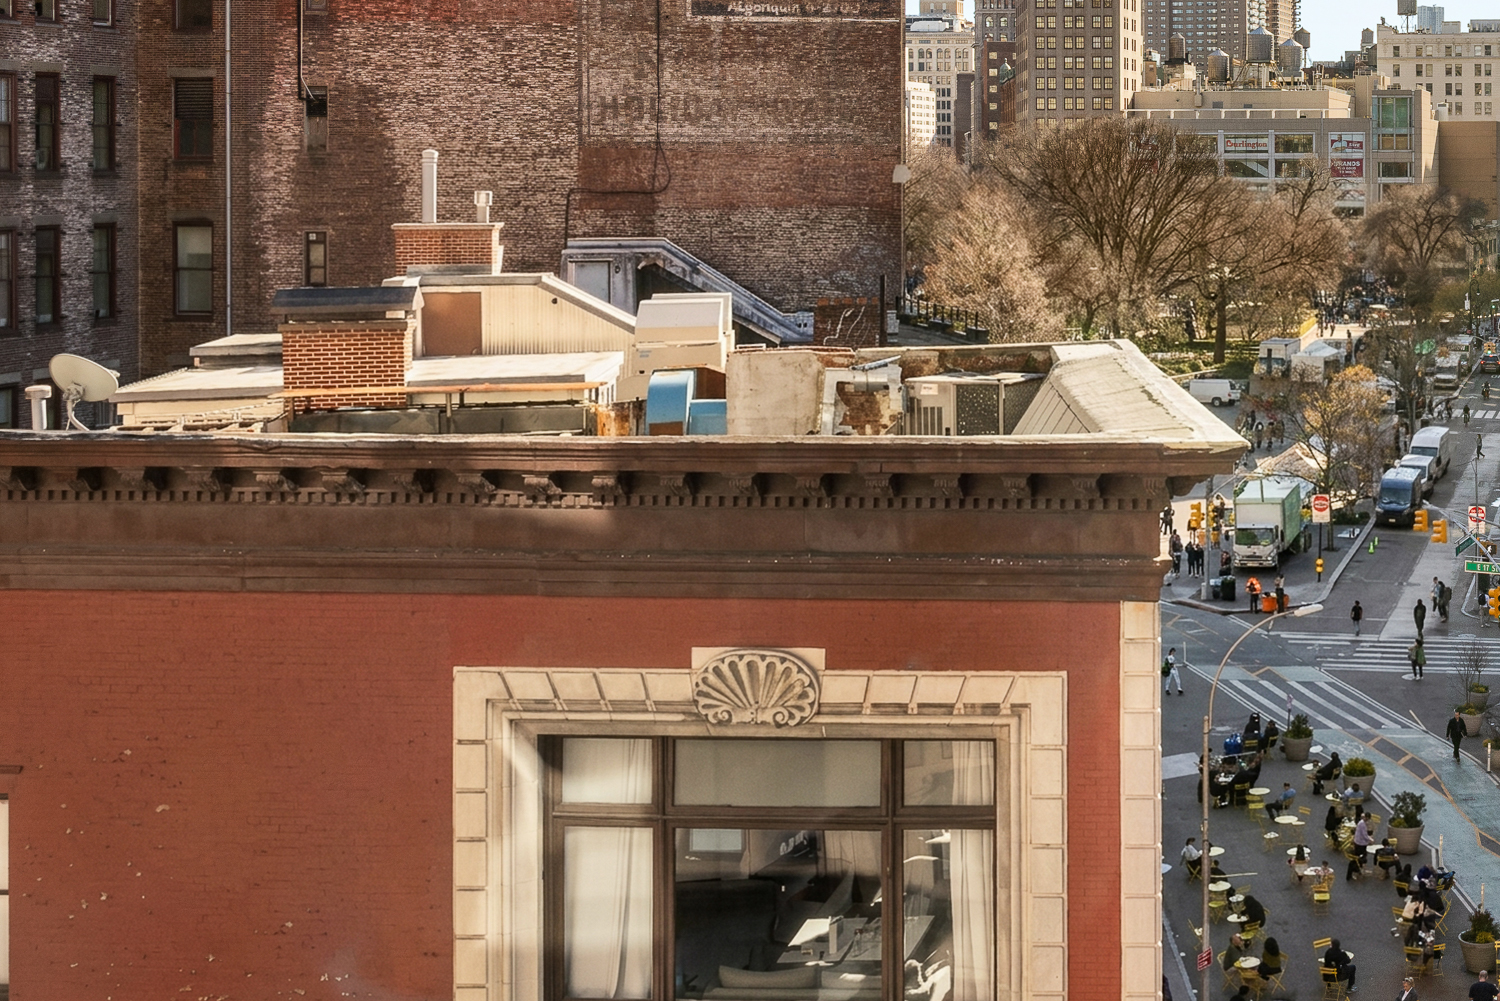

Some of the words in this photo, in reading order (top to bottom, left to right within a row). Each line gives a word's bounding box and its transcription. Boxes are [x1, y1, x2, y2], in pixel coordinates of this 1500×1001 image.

[728, 1, 800, 16] Algonquin
[1226, 140, 1267, 149] Burlington
[1483, 564, 1490, 572] 17
